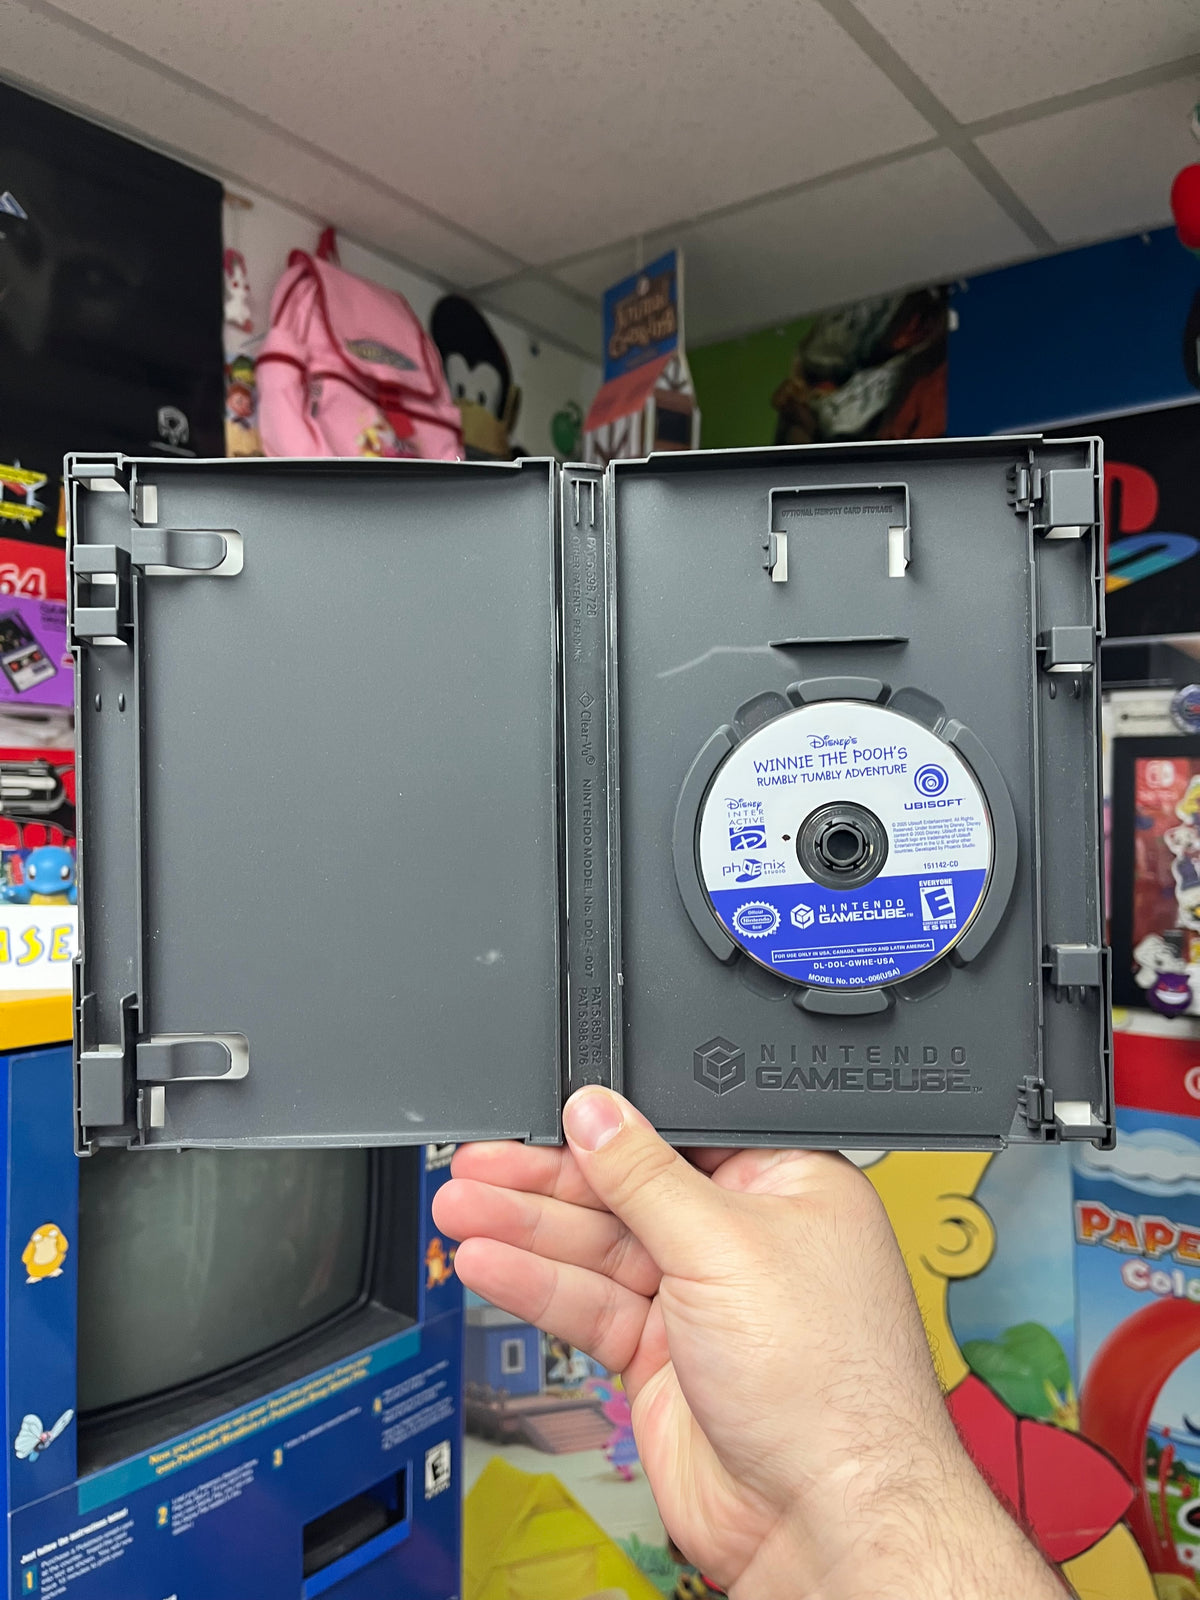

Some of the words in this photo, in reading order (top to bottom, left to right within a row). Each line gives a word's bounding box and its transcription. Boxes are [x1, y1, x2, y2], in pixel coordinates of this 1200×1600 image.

[843, 506, 861, 515] CARD
[862, 505, 893, 514] STORAGE
[0, 563, 46, 600] 64
[753, 754, 814, 773] WINNIE
[818, 751, 848, 768] THE
[853, 745, 908, 763] POOH'S
[757, 774, 798, 787] RUMBLY
[801, 770, 842, 783] TUMBLY
[845, 763, 908, 779] ADVENTURE
[724, 797, 762, 811] Disney
[904, 798, 963, 810] UBISOFT
[582, 778, 593, 845] NINTENDO
[727, 808, 764, 818] INTER
[728, 816, 765, 826] ACTIVE
[583, 848, 593, 891] MODEL
[923, 860, 959, 870] 151142-CD
[919, 878, 953, 887] EVERYONE
[819, 899, 904, 913] NINTENDO
[924, 887, 954, 919] E
[808, 973, 835, 984] MODEL
[836, 977, 848, 985] No.
[760, 1043, 967, 1066] NINTENDO
